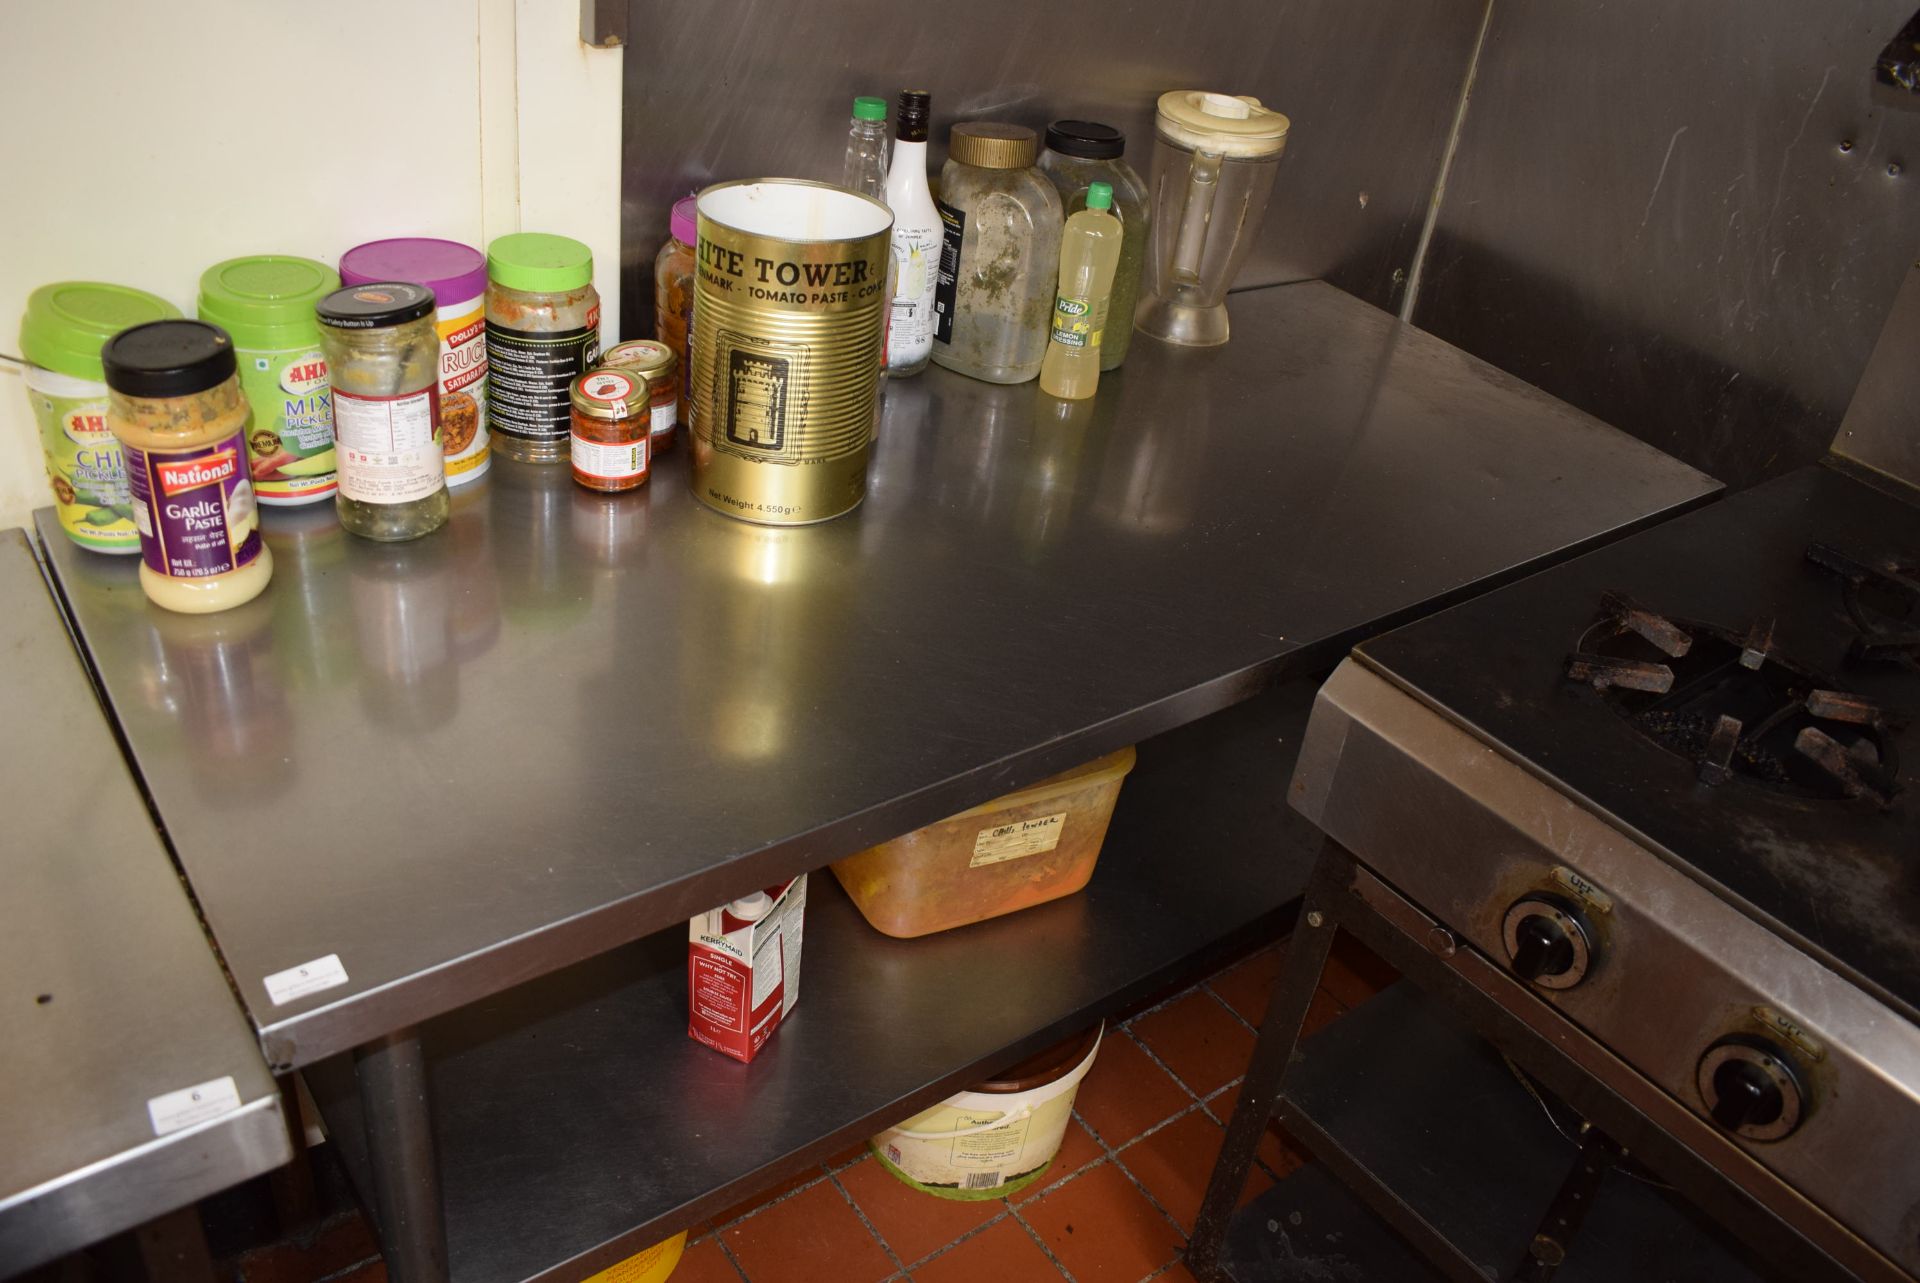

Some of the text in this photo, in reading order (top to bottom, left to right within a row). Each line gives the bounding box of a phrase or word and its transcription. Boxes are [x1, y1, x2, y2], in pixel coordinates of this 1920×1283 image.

[755, 257, 868, 287] TOWER
[749, 286, 807, 303] TOMATO
[812, 291, 848, 304] PASTE
[1059, 300, 1083, 314] Pride
[449, 324, 479, 344] DOLLY'S
[1056, 330, 1079, 340] LEMON
[447, 367, 481, 390] SATKARA
[286, 393, 331, 416] MIX
[287, 411, 333, 426] PICKLE
[165, 458, 234, 485] National
[708, 488, 722, 499] Net
[723, 494, 754, 510] Weight
[700, 934, 743, 957] KERRYMAID
[699, 961, 714, 970] WHY
[714, 966, 726, 975] NOT
[710, 953, 733, 965] SINGLE
